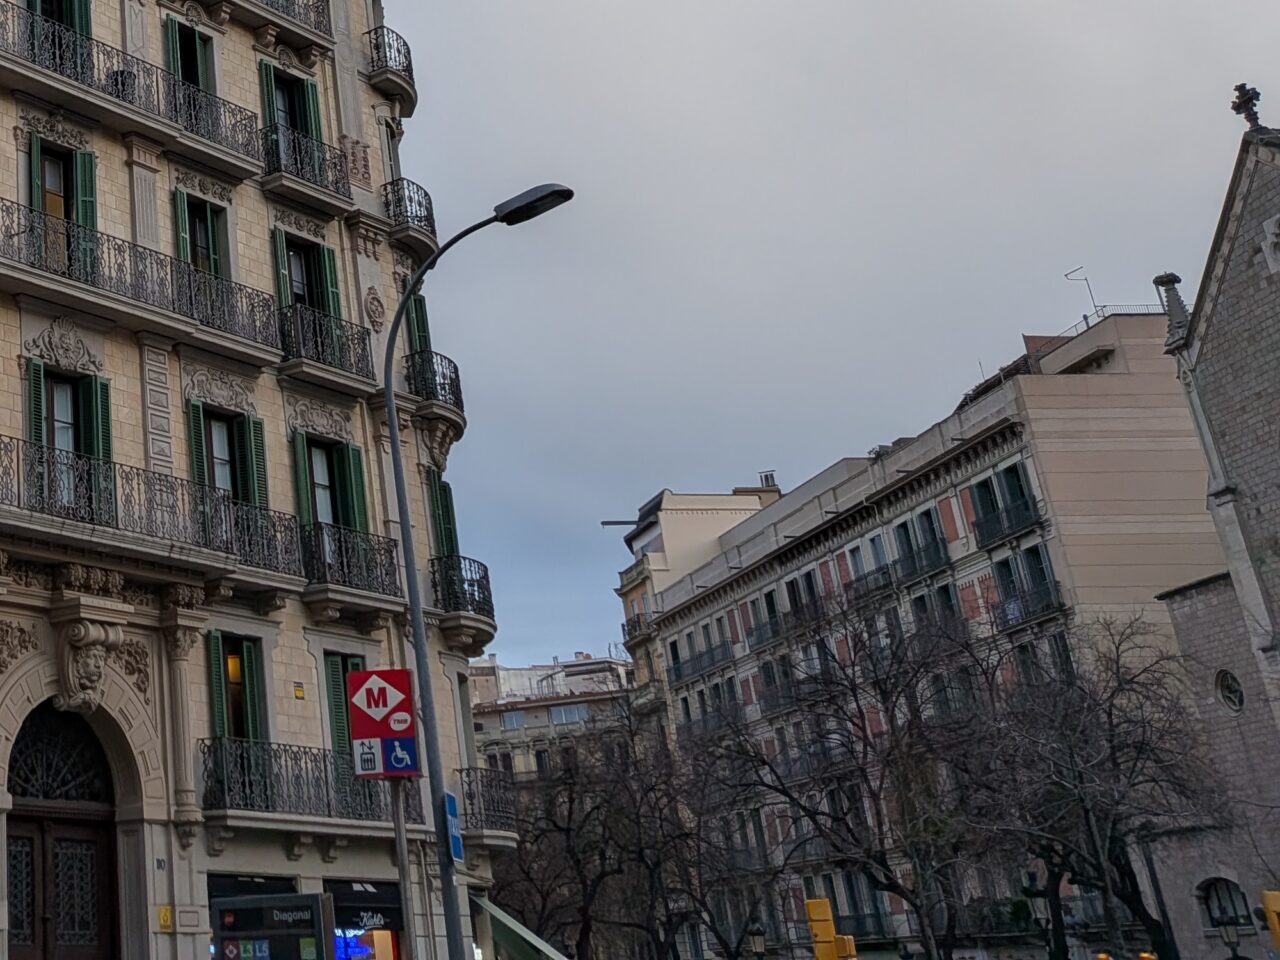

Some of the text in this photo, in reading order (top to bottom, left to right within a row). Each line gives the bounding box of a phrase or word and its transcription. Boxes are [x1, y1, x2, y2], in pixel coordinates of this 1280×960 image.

[365, 687, 388, 709] M
[273, 909, 311, 922] Diagonal
[240, 944, 253, 957] L3
